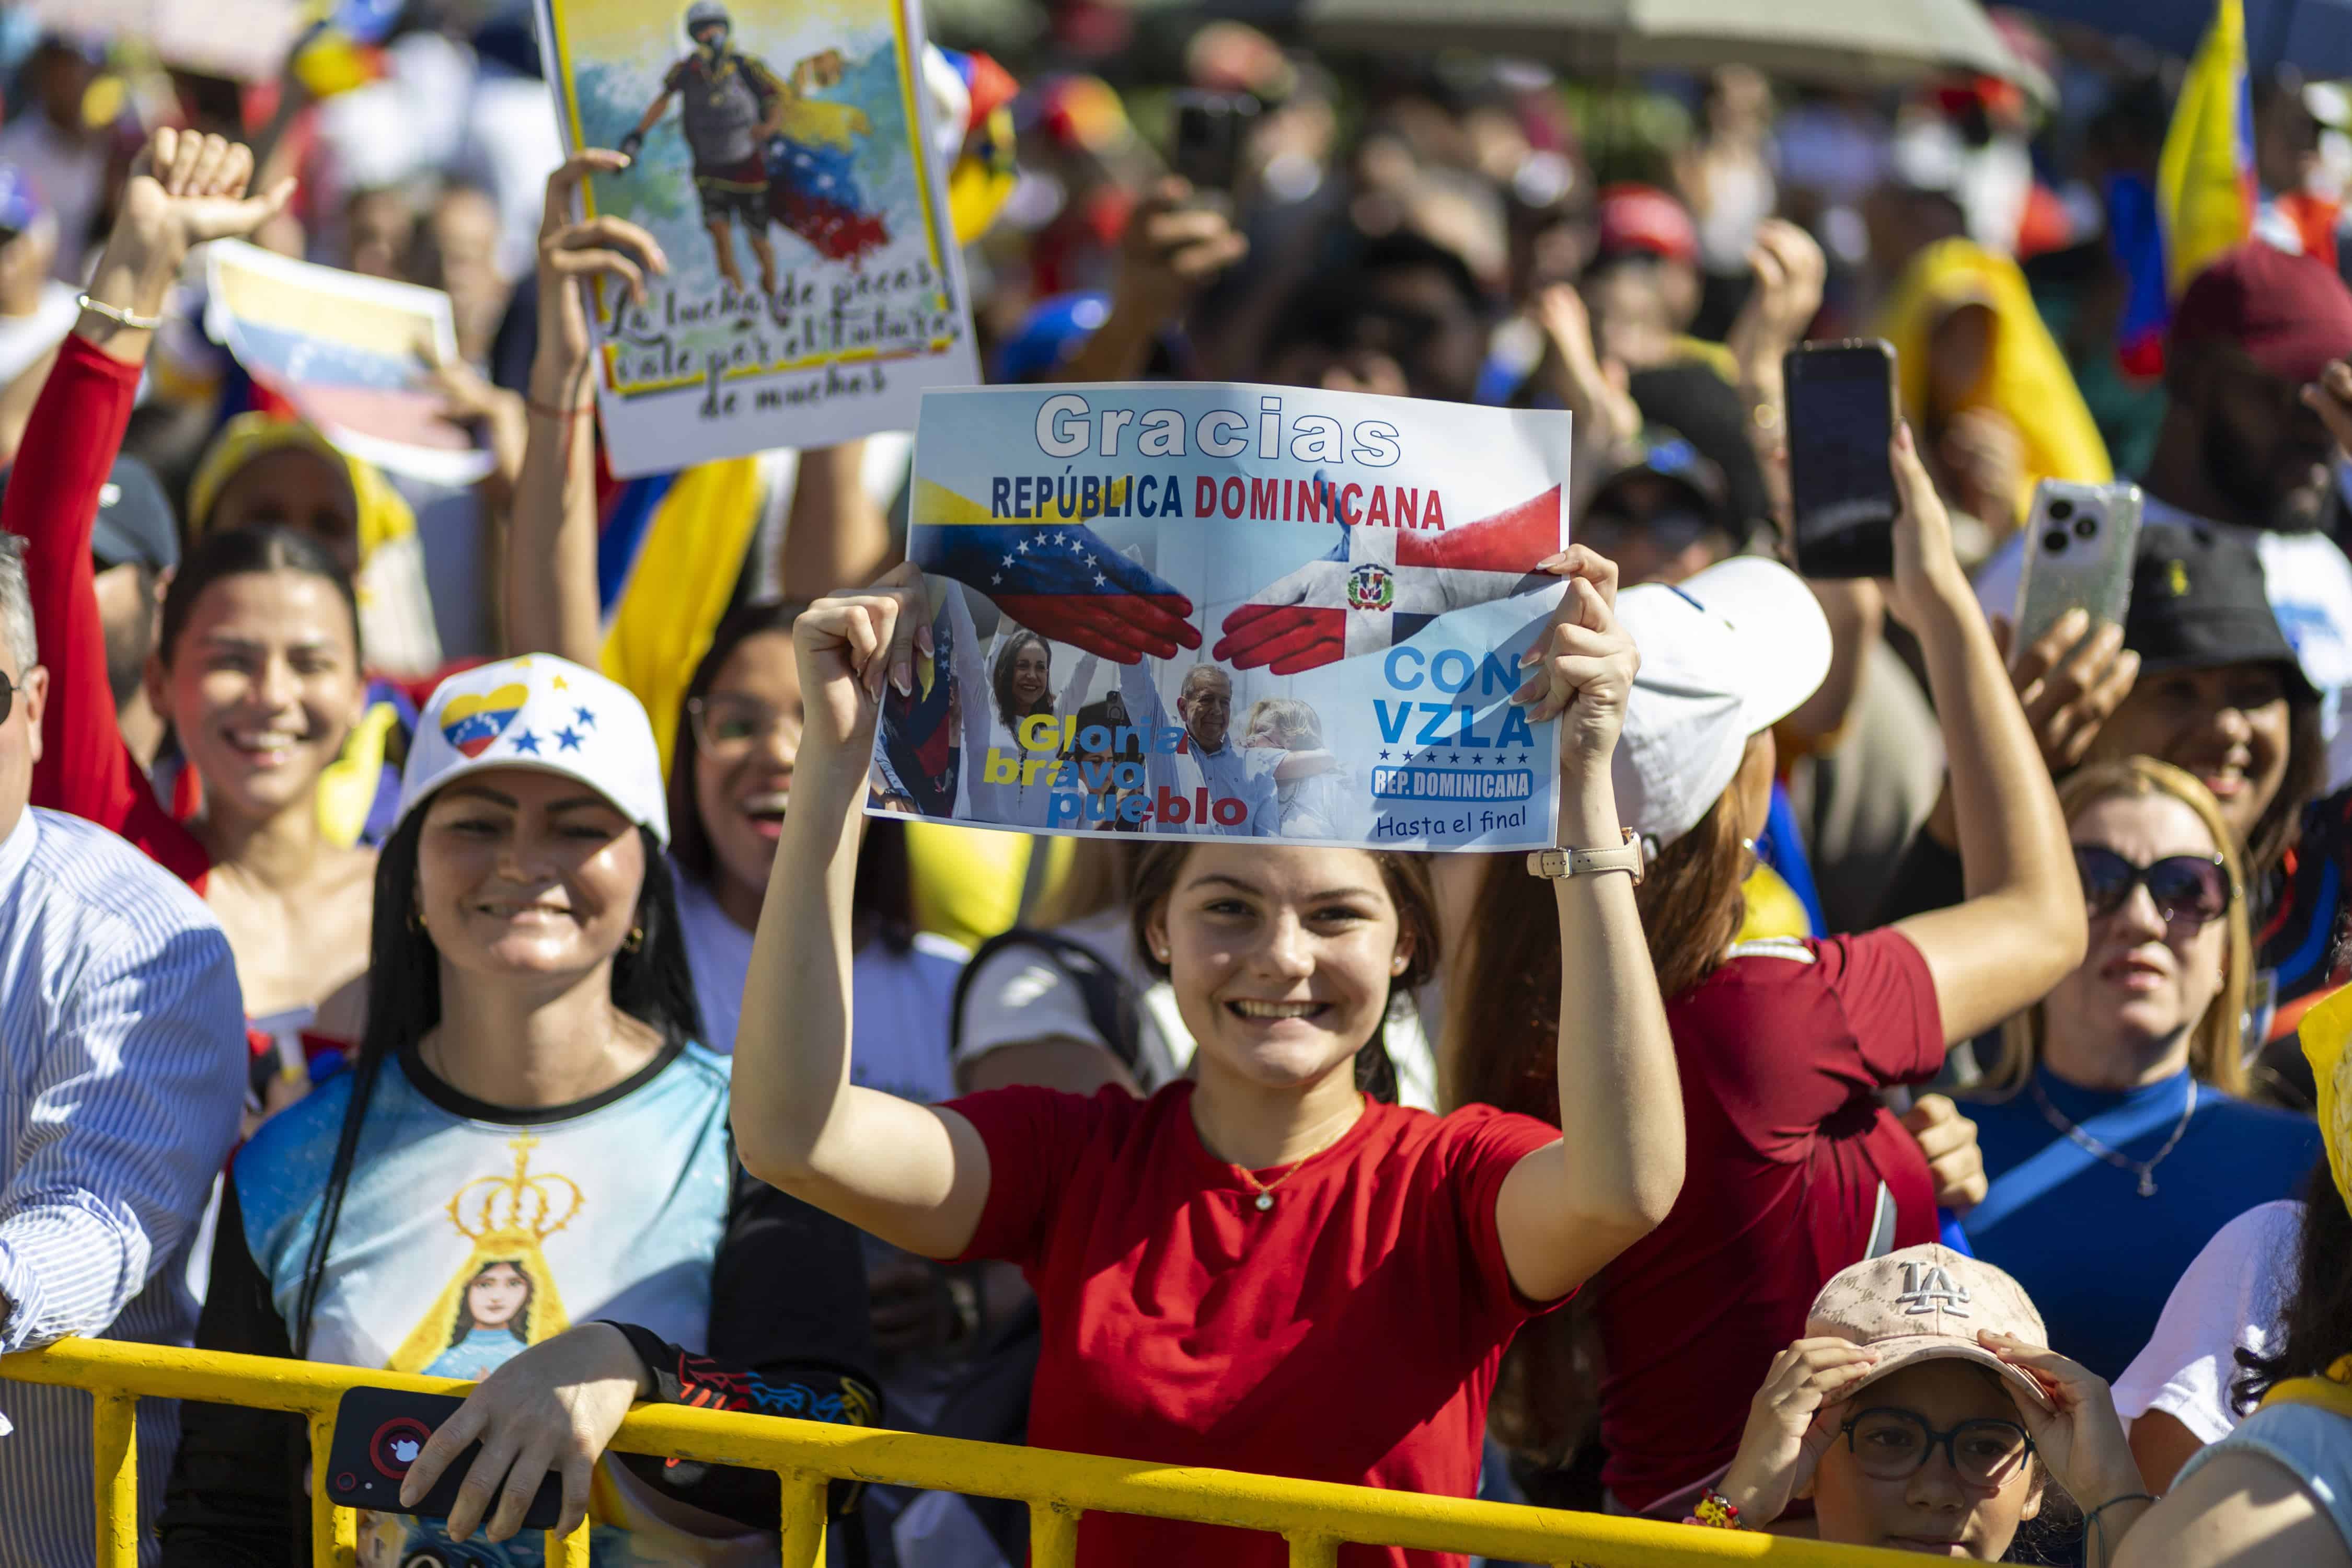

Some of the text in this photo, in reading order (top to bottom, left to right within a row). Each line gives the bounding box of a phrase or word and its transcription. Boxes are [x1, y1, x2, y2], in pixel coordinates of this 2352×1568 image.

[608, 285, 653, 341] La
[665, 285, 759, 327] lucha
[775, 272, 814, 309] de
[785, 314, 815, 359] el
[699, 363, 887, 419] de muchos
[1035, 393, 1401, 467] Gracias
[991, 465, 1445, 531] REPÚBLICA DOMINICANA
[1384, 646, 1522, 696] CON
[1019, 713, 1189, 755] Gloria
[1373, 699, 1535, 748] VZLA
[983, 748, 1145, 790] bravo
[1374, 769, 1529, 798] REP. DOMINICANA
[1047, 786, 1248, 828] pueblo
[1377, 805, 1526, 837] Hasta el final
[1896, 1261, 1970, 1318] LA
